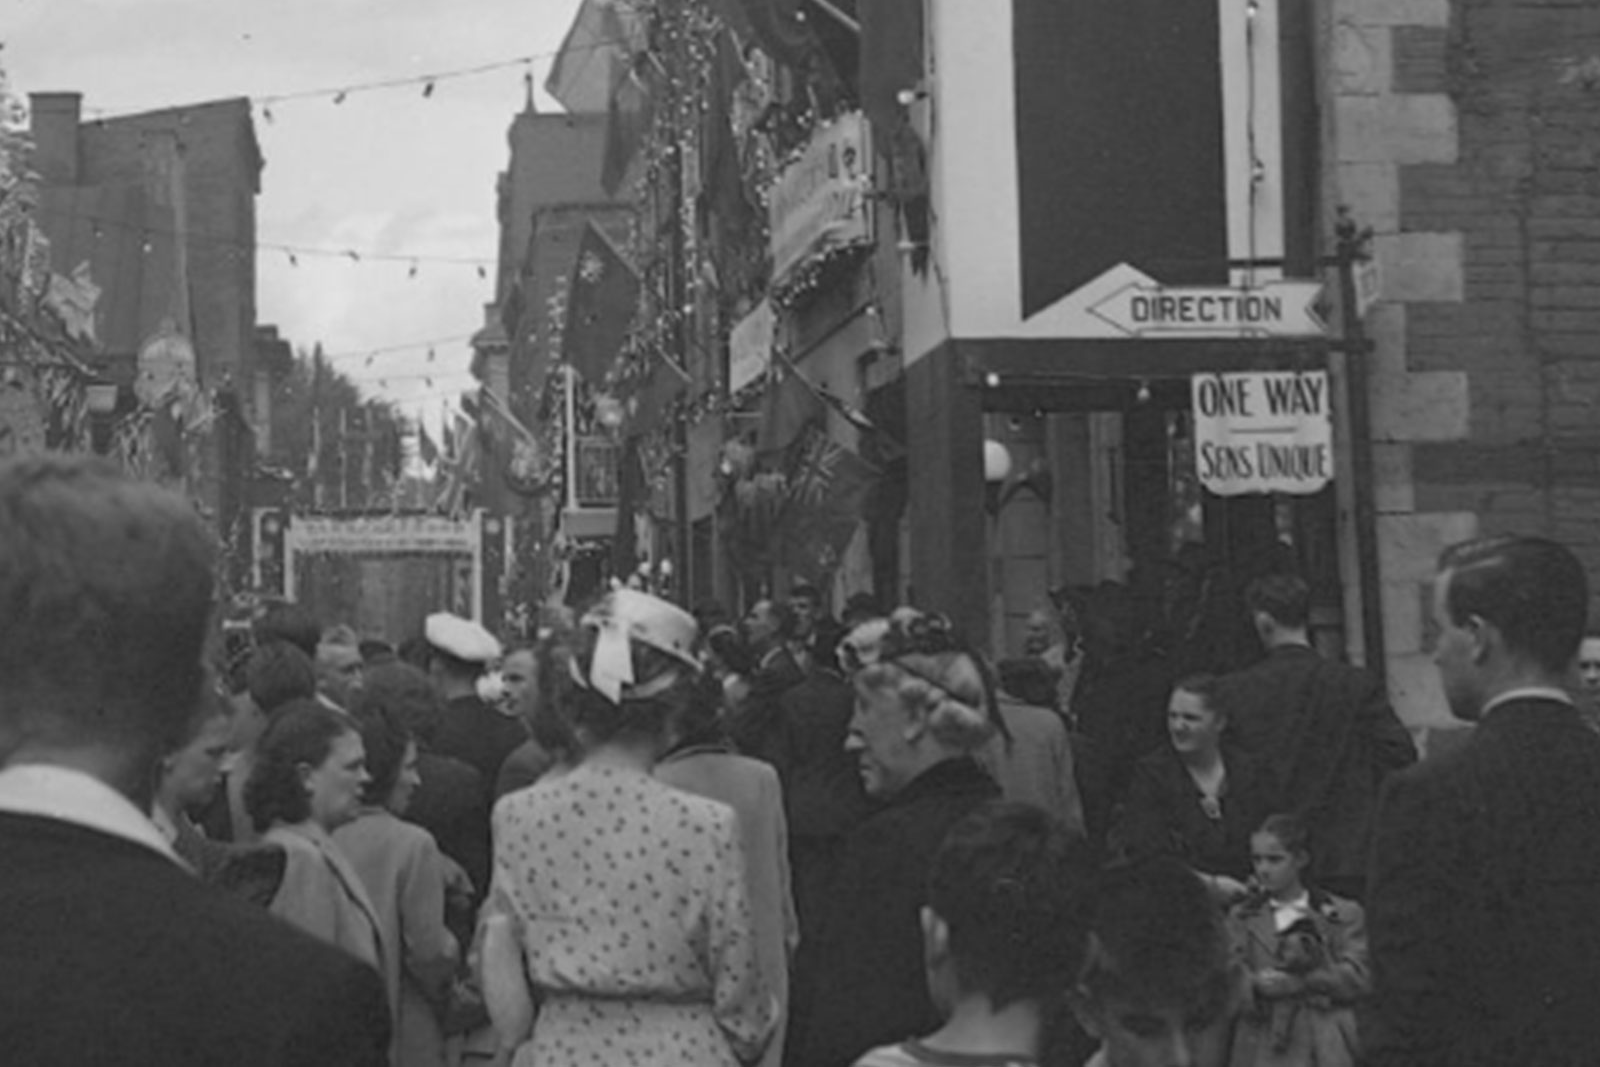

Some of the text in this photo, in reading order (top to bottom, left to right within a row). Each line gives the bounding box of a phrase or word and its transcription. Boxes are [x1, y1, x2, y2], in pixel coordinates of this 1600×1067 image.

[1131, 295, 1283, 323] DIRECTION
[1200, 377, 1324, 418] ONE WAY
[1200, 441, 1328, 481] SENS UNIQUE
